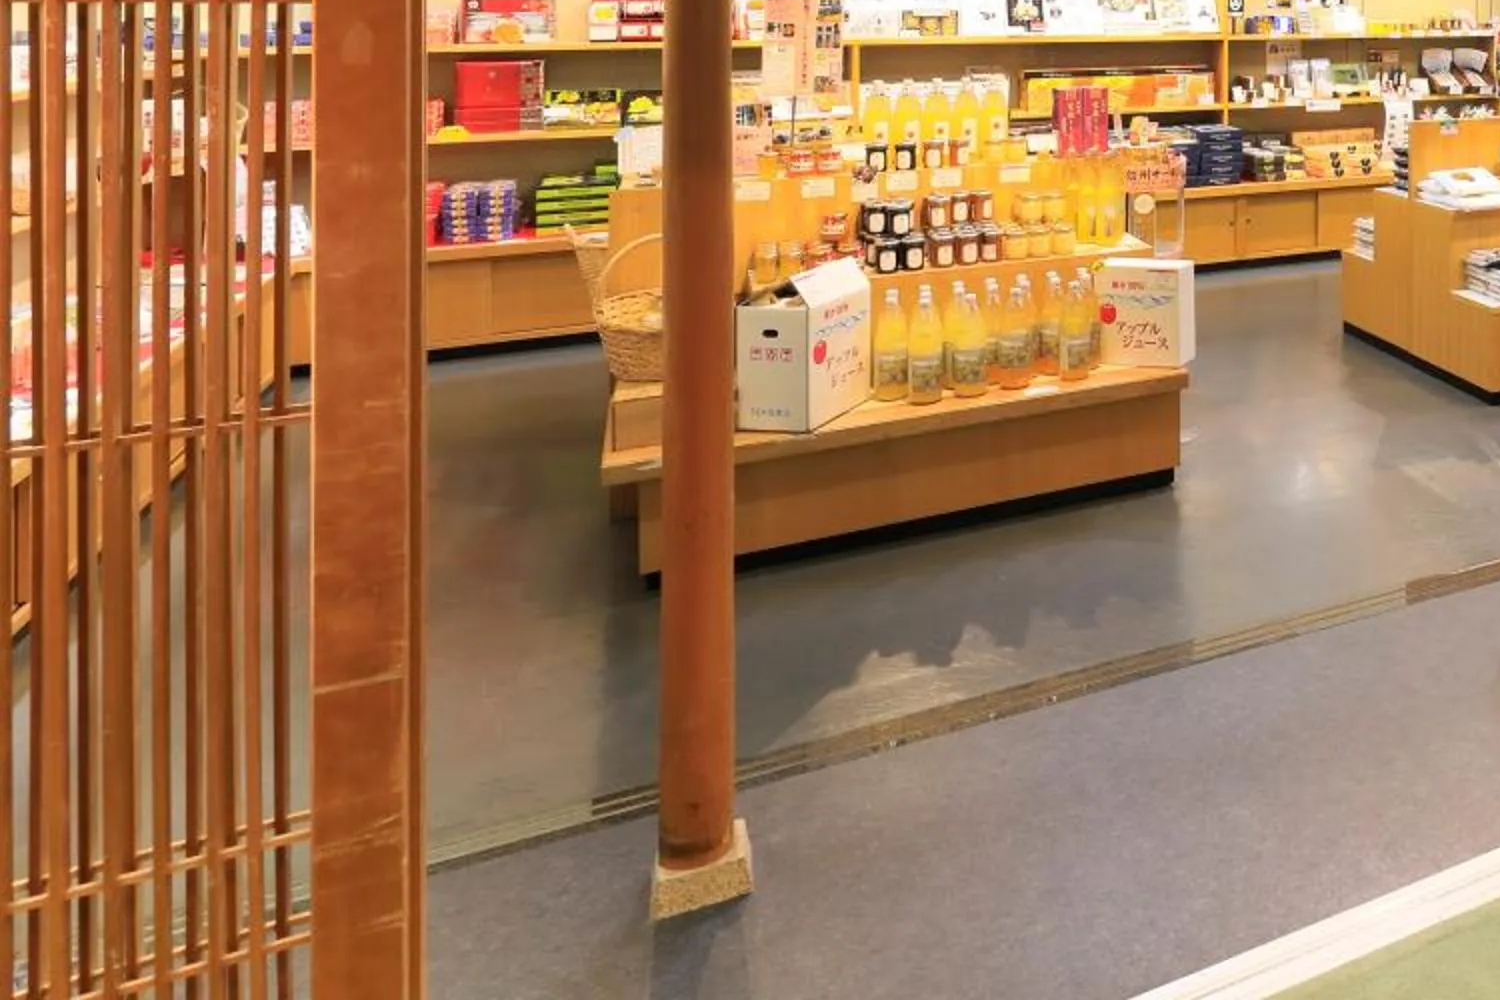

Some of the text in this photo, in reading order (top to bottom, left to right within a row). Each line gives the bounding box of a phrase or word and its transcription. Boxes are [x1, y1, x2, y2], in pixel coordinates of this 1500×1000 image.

[1116, 321, 1161, 335] アップル
[1122, 335, 1169, 350] ジュース
